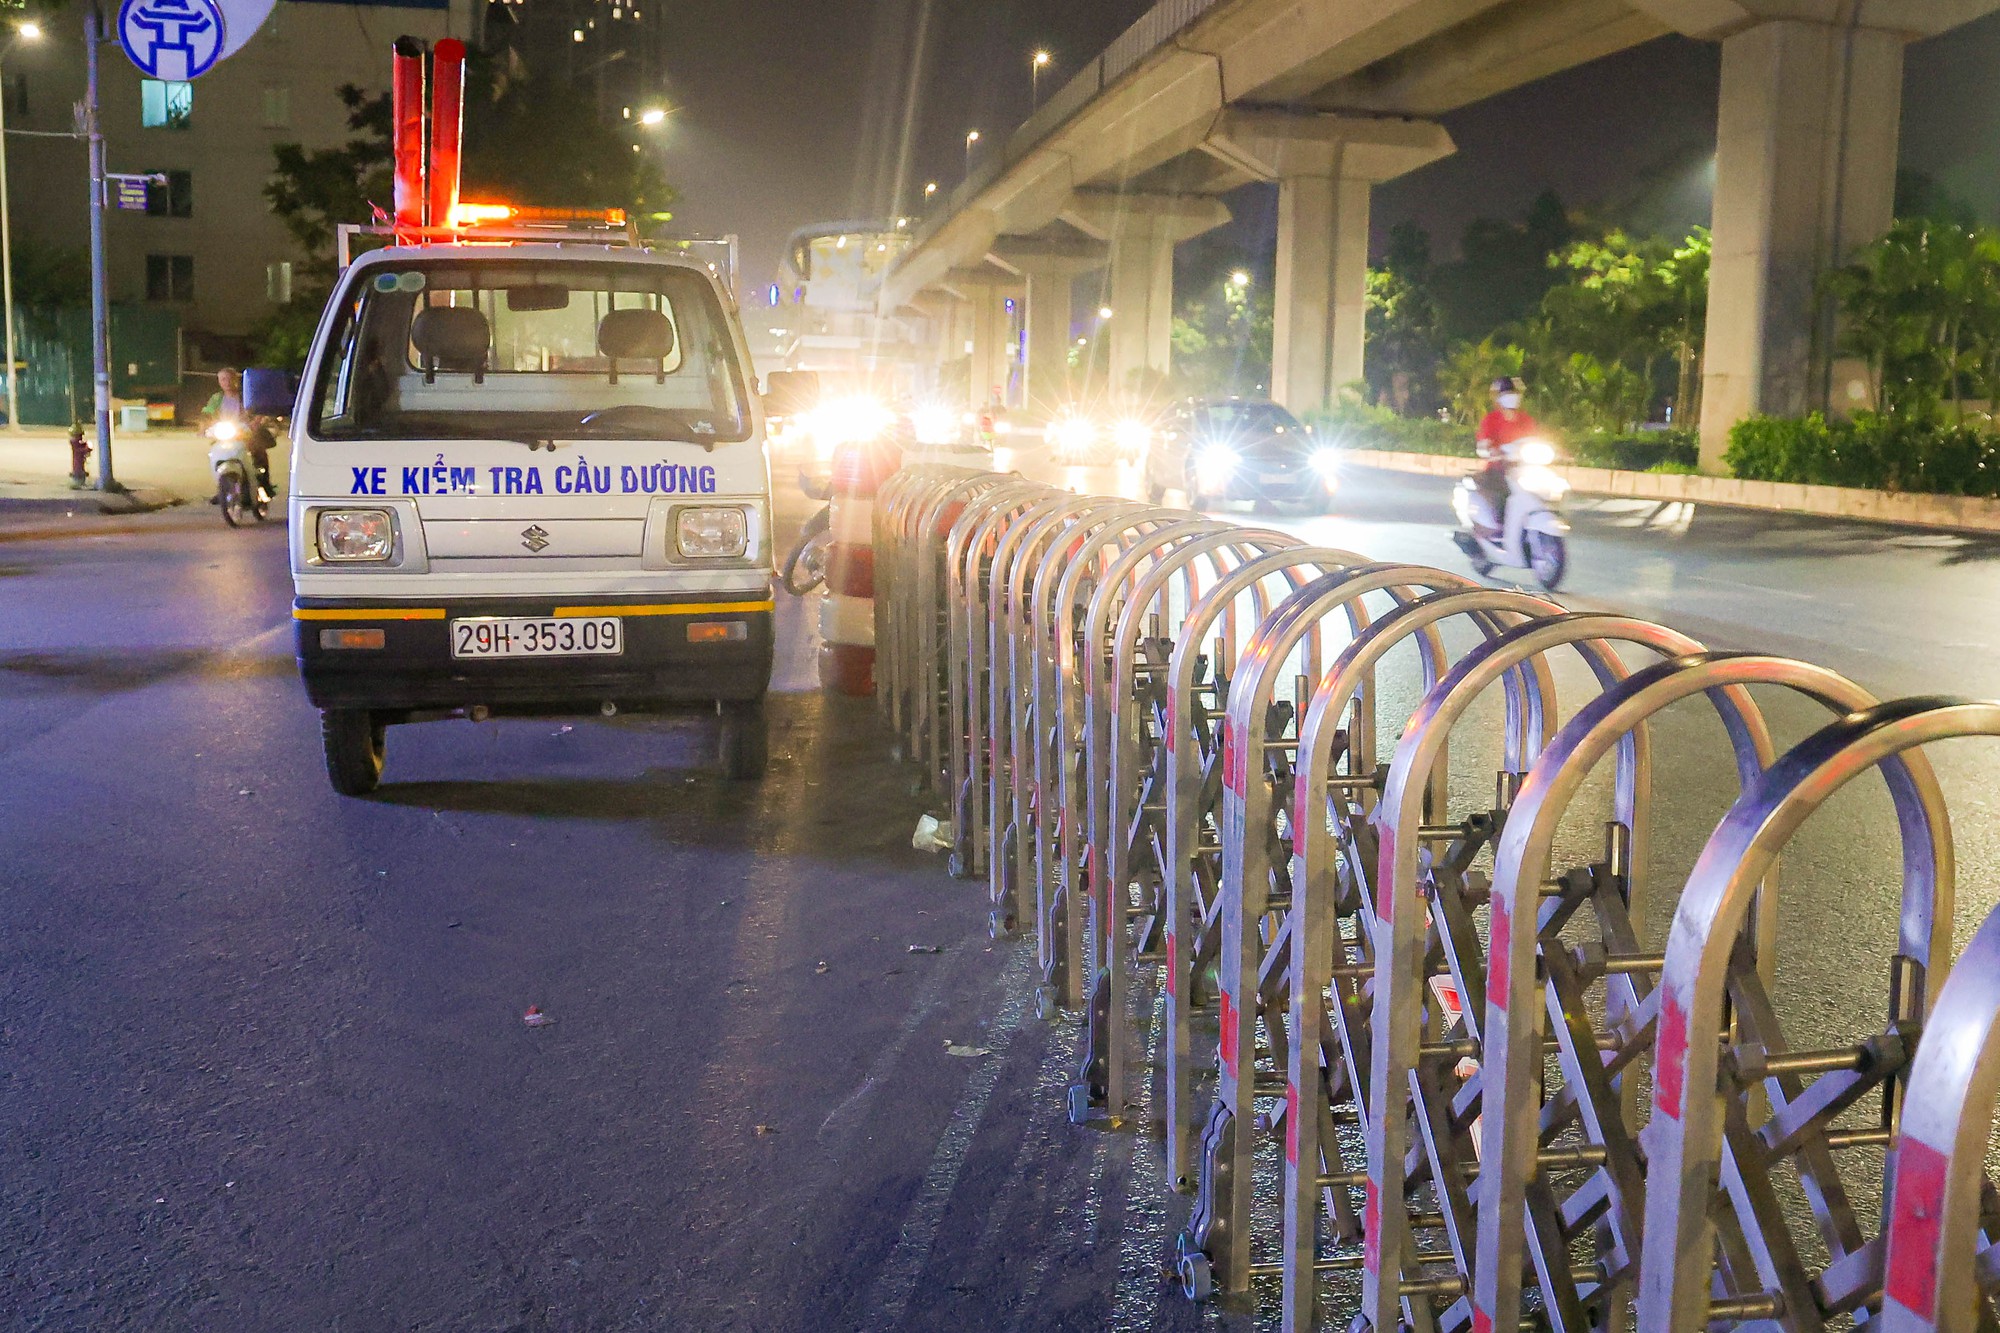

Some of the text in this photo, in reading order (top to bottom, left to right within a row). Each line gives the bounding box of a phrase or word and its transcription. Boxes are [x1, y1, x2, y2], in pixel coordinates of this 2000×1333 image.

[351, 467, 386, 494] XE
[402, 453, 475, 494] KIỂM
[488, 467, 543, 494] TRA
[555, 455, 611, 494] CẦU
[458, 621, 615, 653] 29H-353.09
